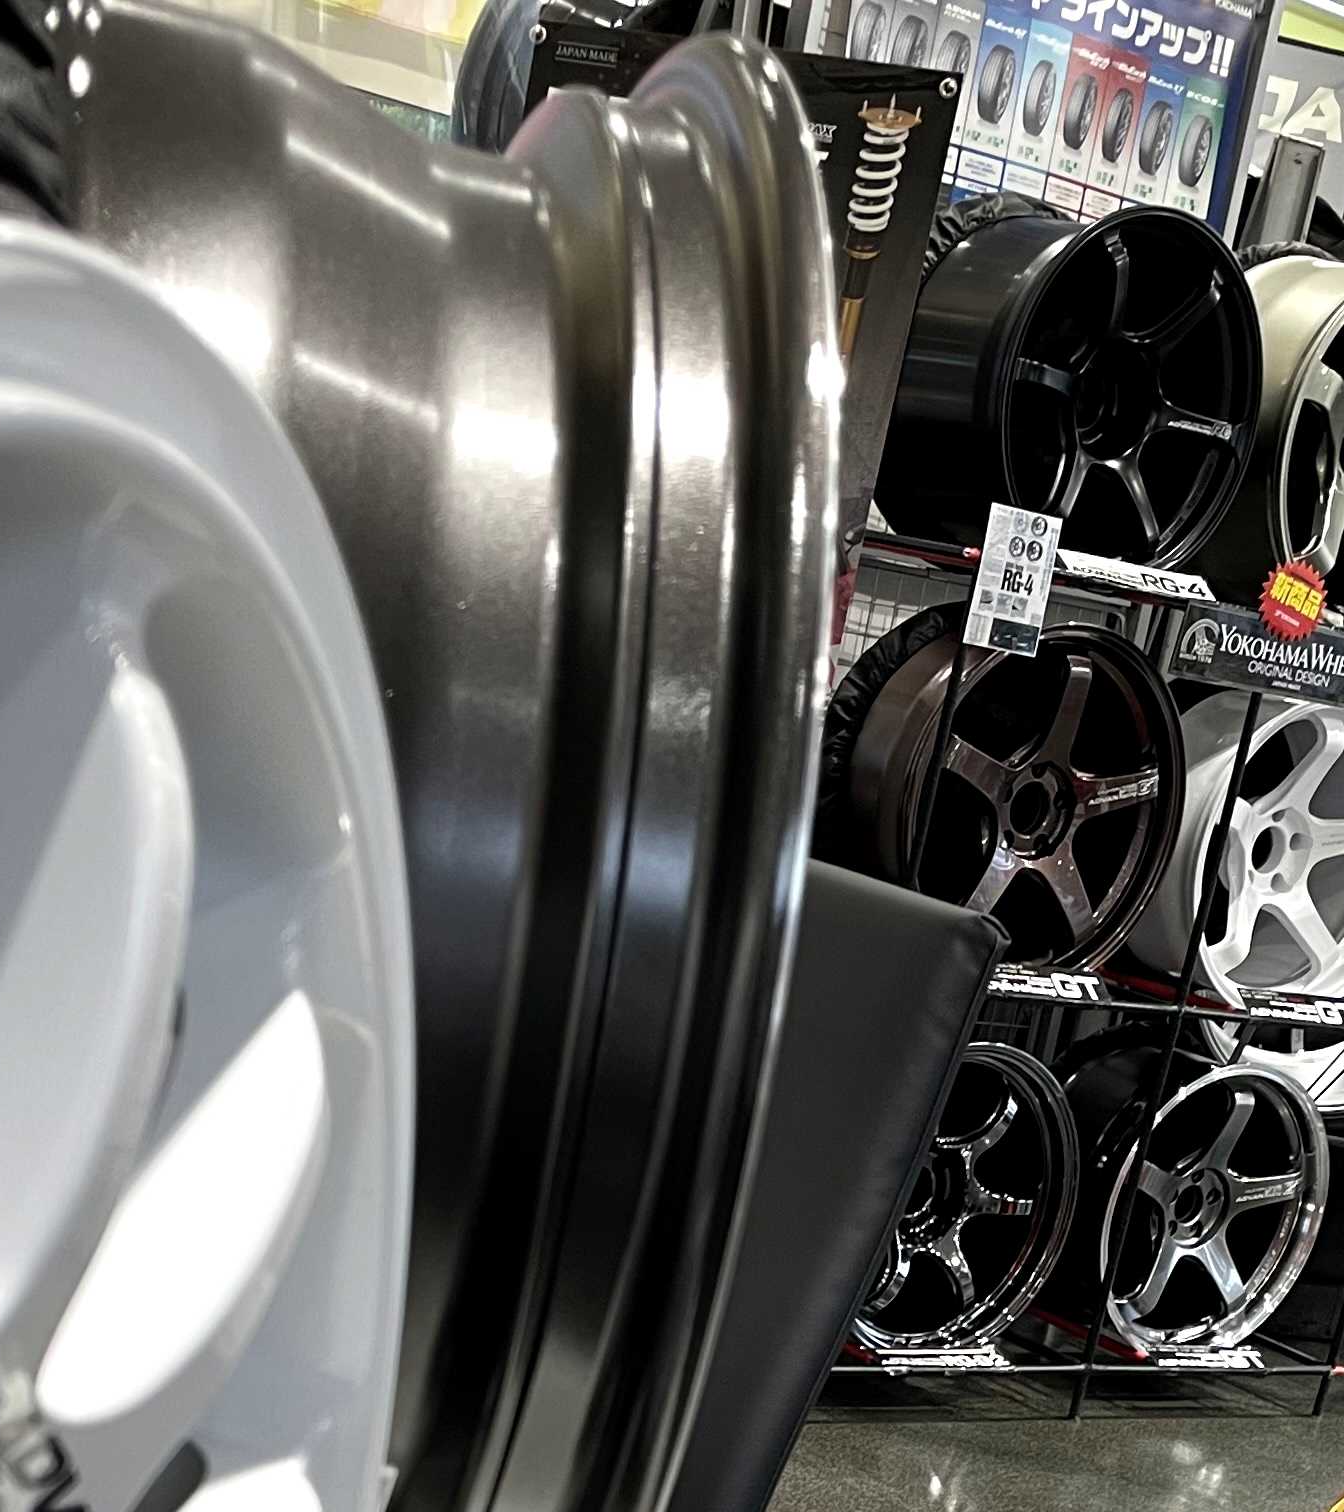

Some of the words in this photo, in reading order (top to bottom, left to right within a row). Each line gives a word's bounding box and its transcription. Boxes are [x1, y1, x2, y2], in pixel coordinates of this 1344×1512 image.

[1001, 569, 1034, 596] RG-4
[1141, 573, 1206, 598] RG-4
[1269, 571, 1323, 621] 新商品
[1219, 623, 1309, 668] YOKOHAMA
[1247, 661, 1294, 681] ORIGINAL
[1294, 671, 1331, 688] DESIGN
[1050, 972, 1100, 1001] GT
